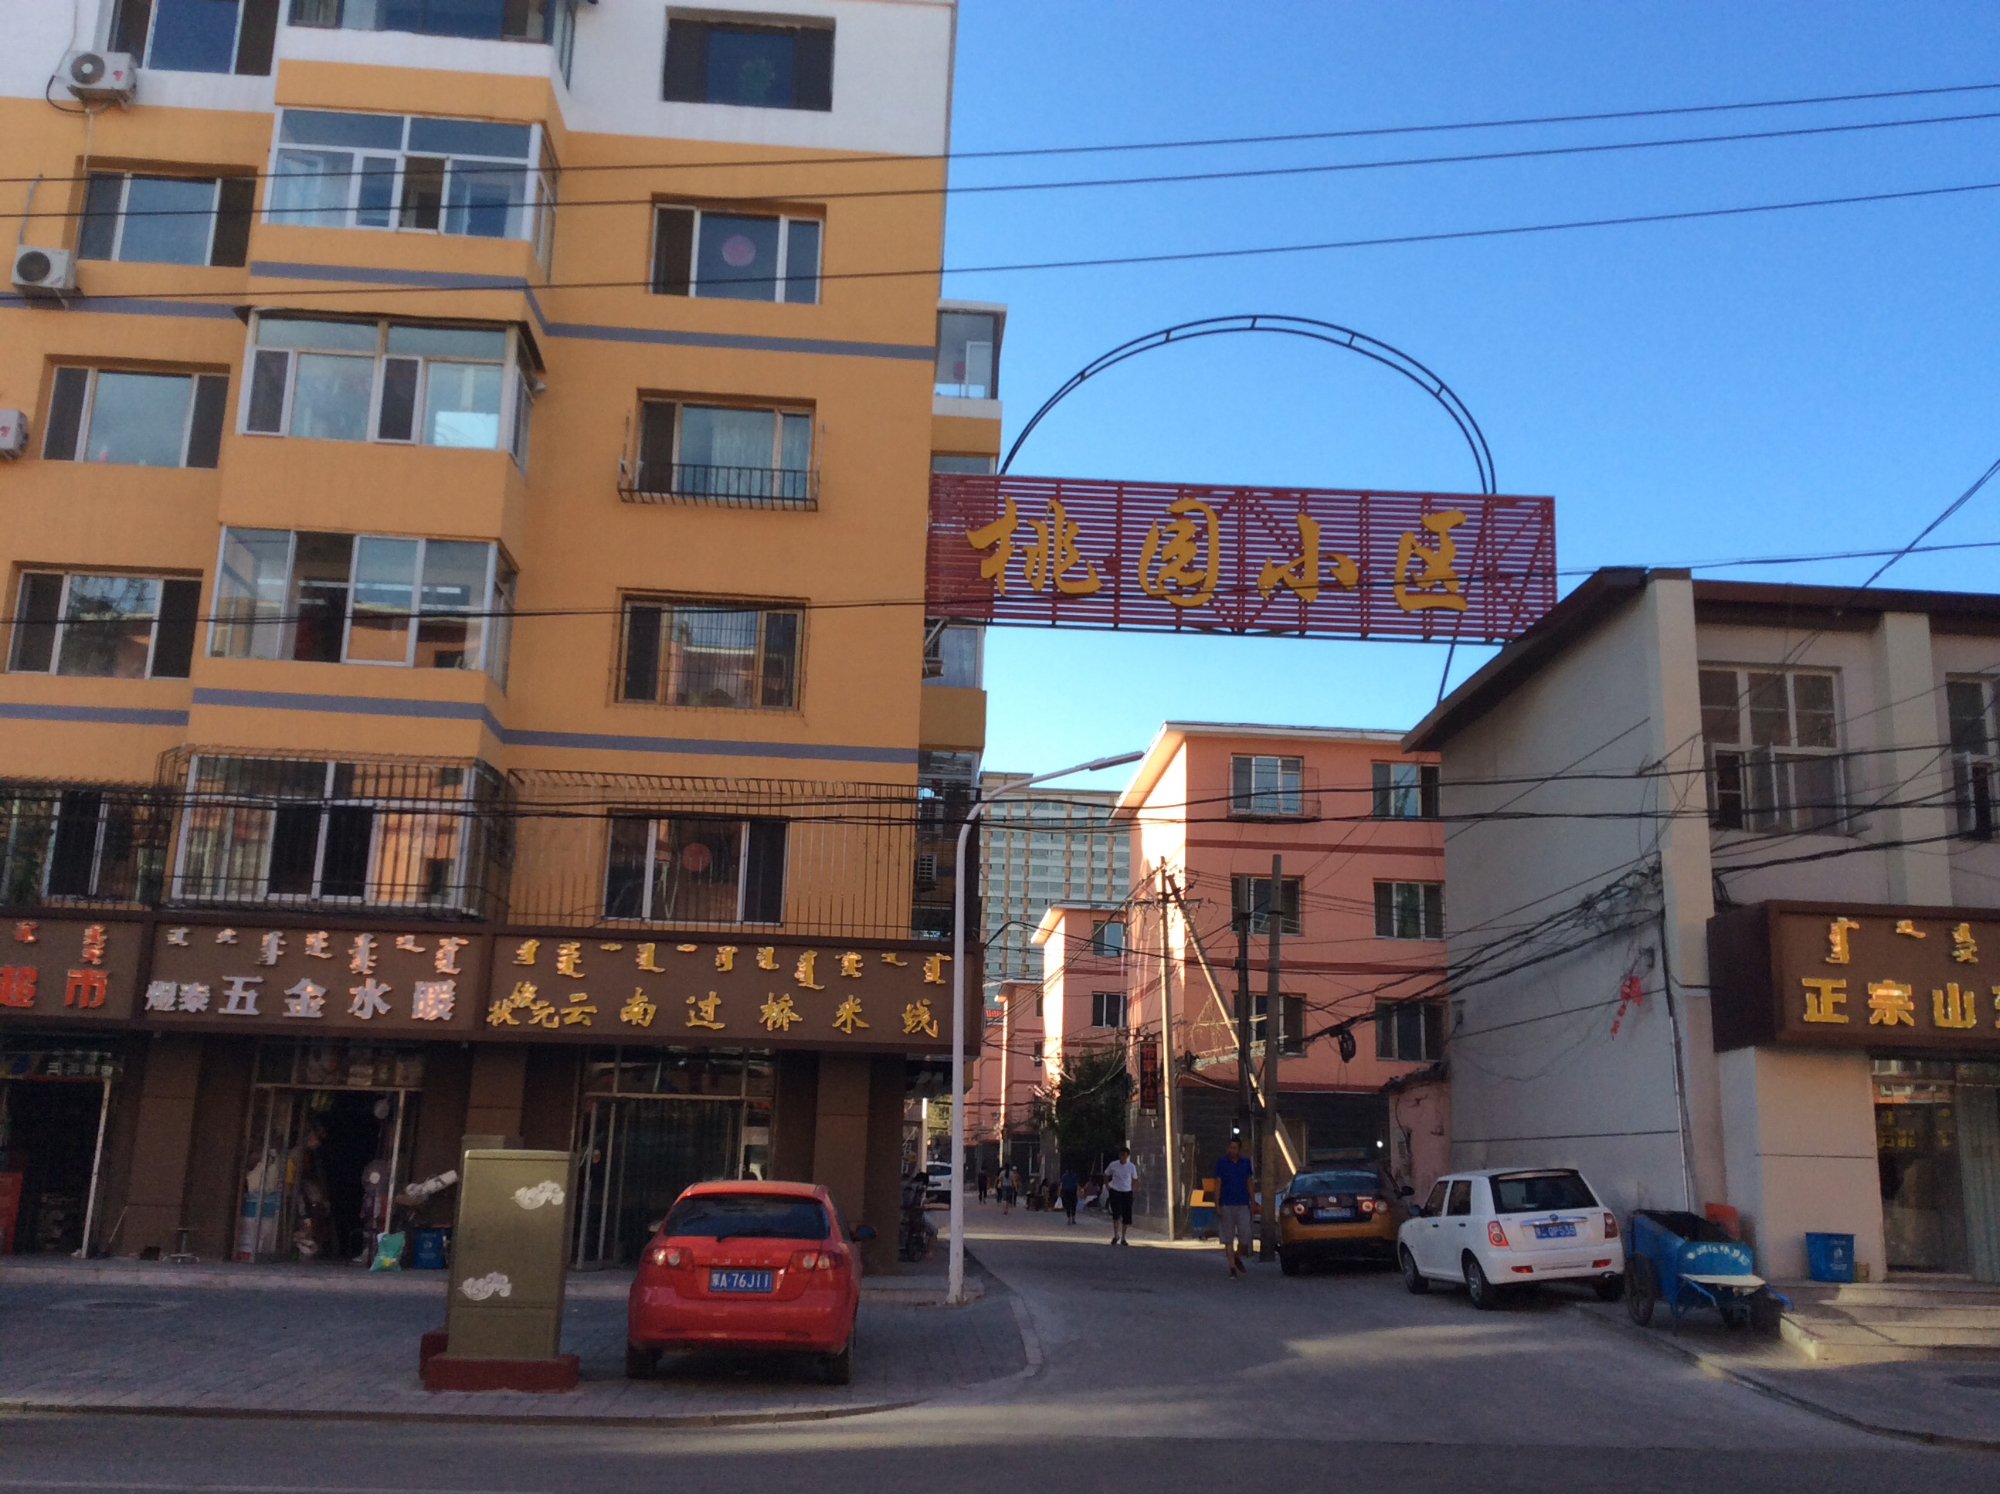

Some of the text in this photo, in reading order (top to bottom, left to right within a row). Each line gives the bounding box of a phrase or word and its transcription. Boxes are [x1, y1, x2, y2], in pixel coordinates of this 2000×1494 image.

[966, 495, 1469, 612] 桃园小区
[1802, 978, 2000, 1029] 正宗山
